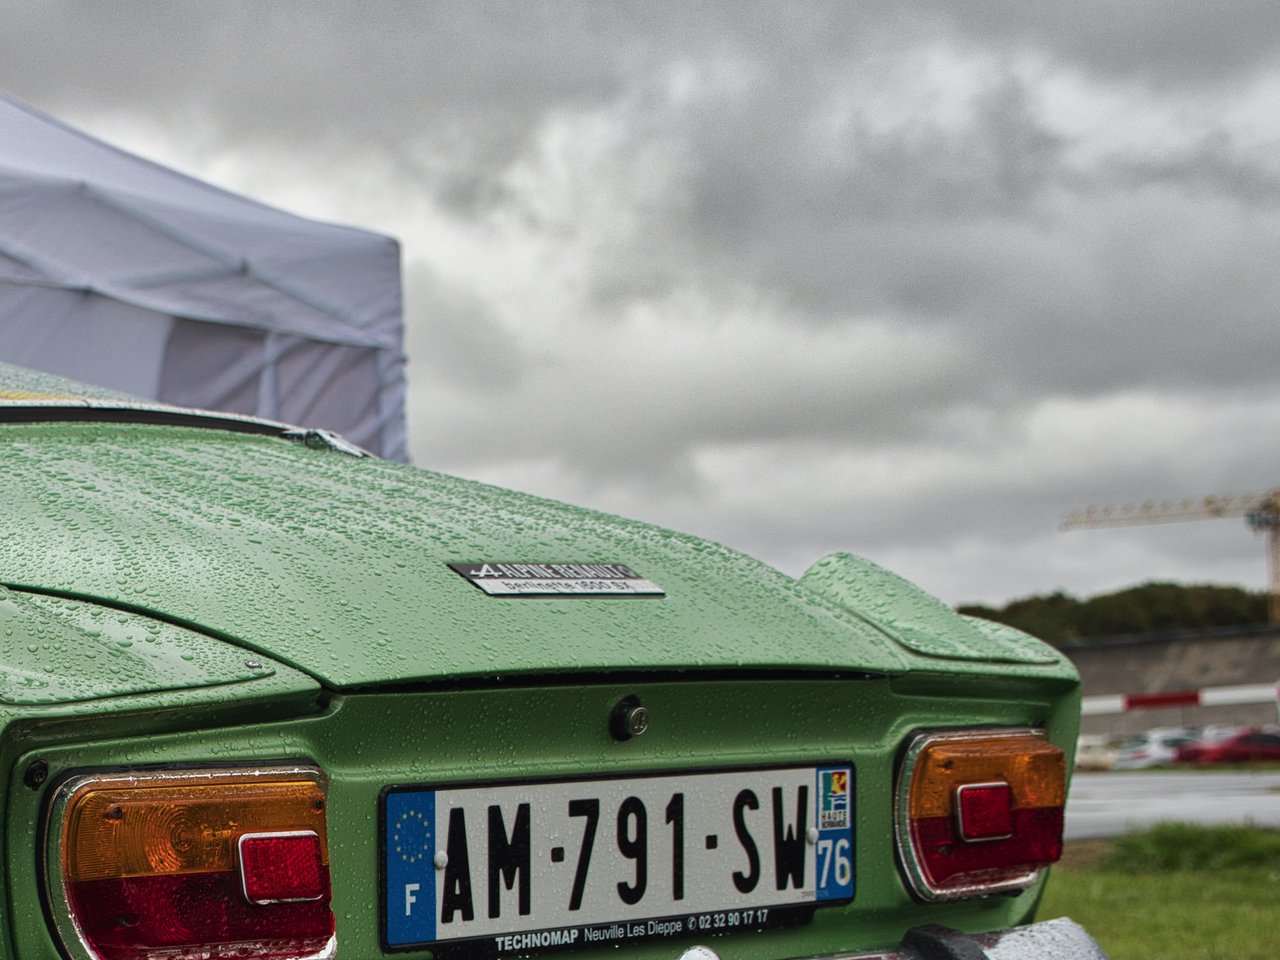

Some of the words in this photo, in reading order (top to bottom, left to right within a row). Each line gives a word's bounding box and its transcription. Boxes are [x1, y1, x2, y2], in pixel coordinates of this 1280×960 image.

[817, 838, 851, 889] 76
[405, 883, 420, 916] F
[495, 929, 578, 951] TECHNOMAP
[584, 925, 624, 941] Neuville
[627, 923, 645, 937] Les
[647, 920, 682, 936] Dieppe
[699, 915, 711, 929] 02
[713, 913, 726, 928] 32
[727, 912, 740, 926] 90
[742, 910, 754, 925] 17
[756, 909, 769, 923] 17
